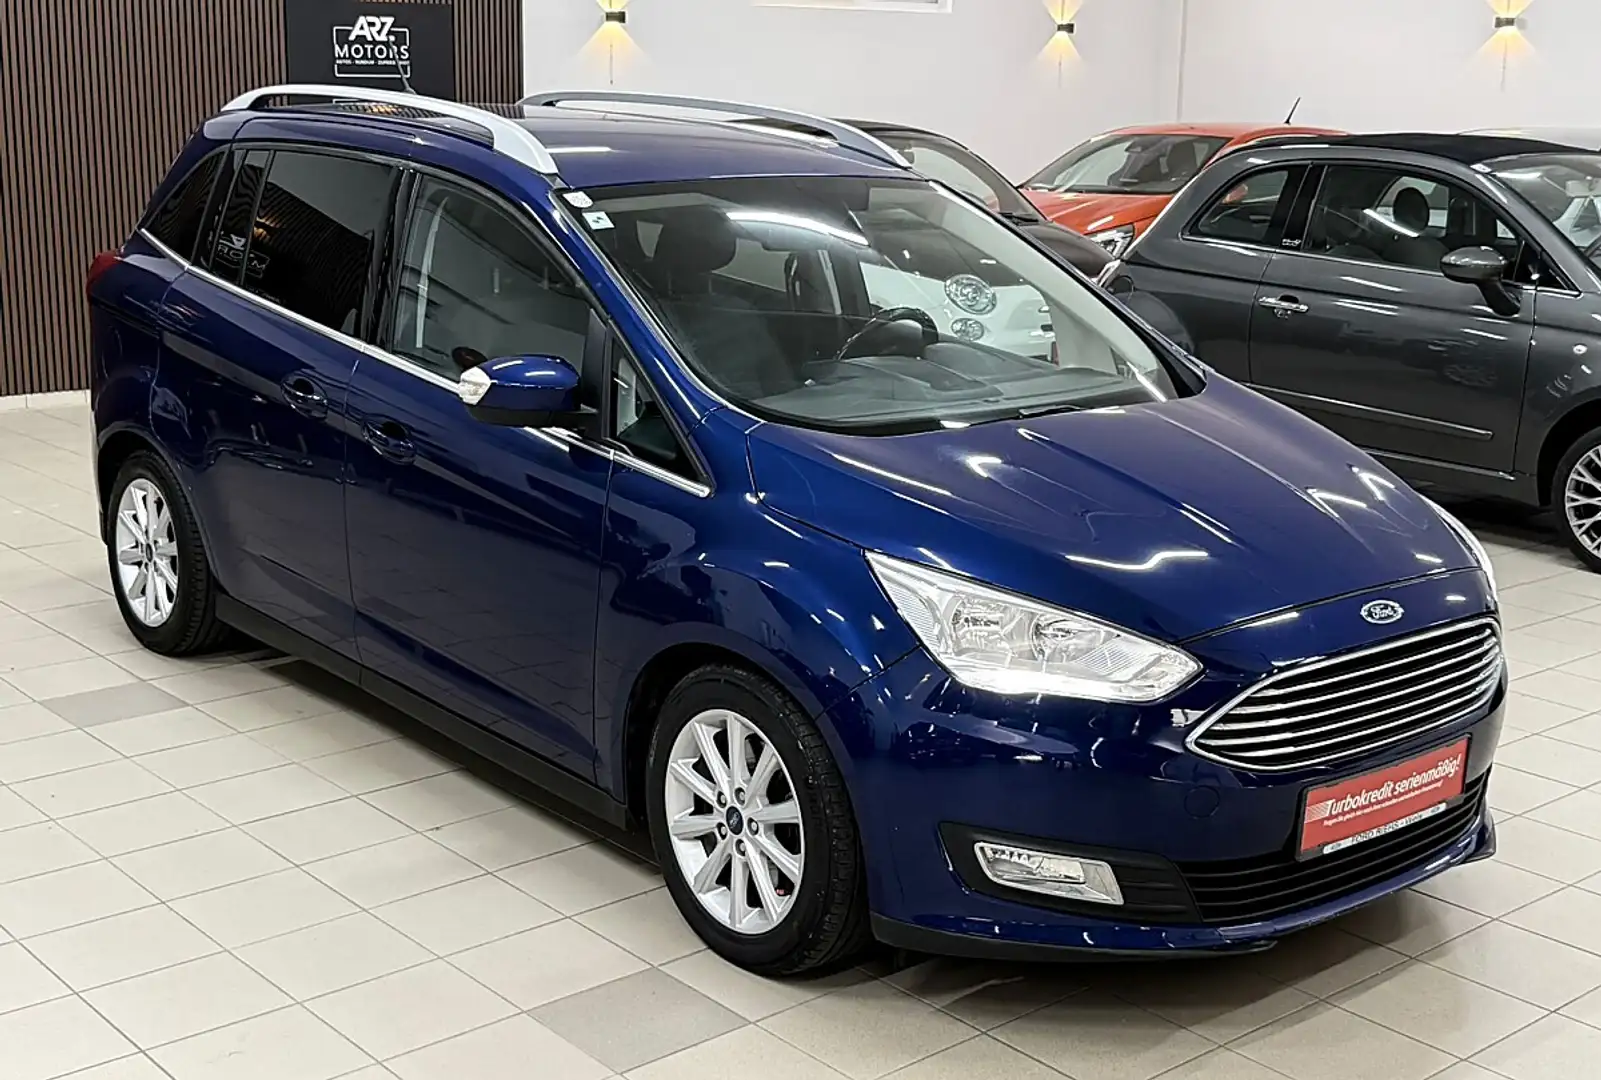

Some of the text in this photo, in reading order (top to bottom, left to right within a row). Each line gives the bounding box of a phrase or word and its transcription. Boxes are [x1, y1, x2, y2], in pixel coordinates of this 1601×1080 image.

[335, 44, 409, 59] MOTORS
[1370, 604, 1395, 619] Ford
[1327, 781, 1393, 817] Turbokredit
